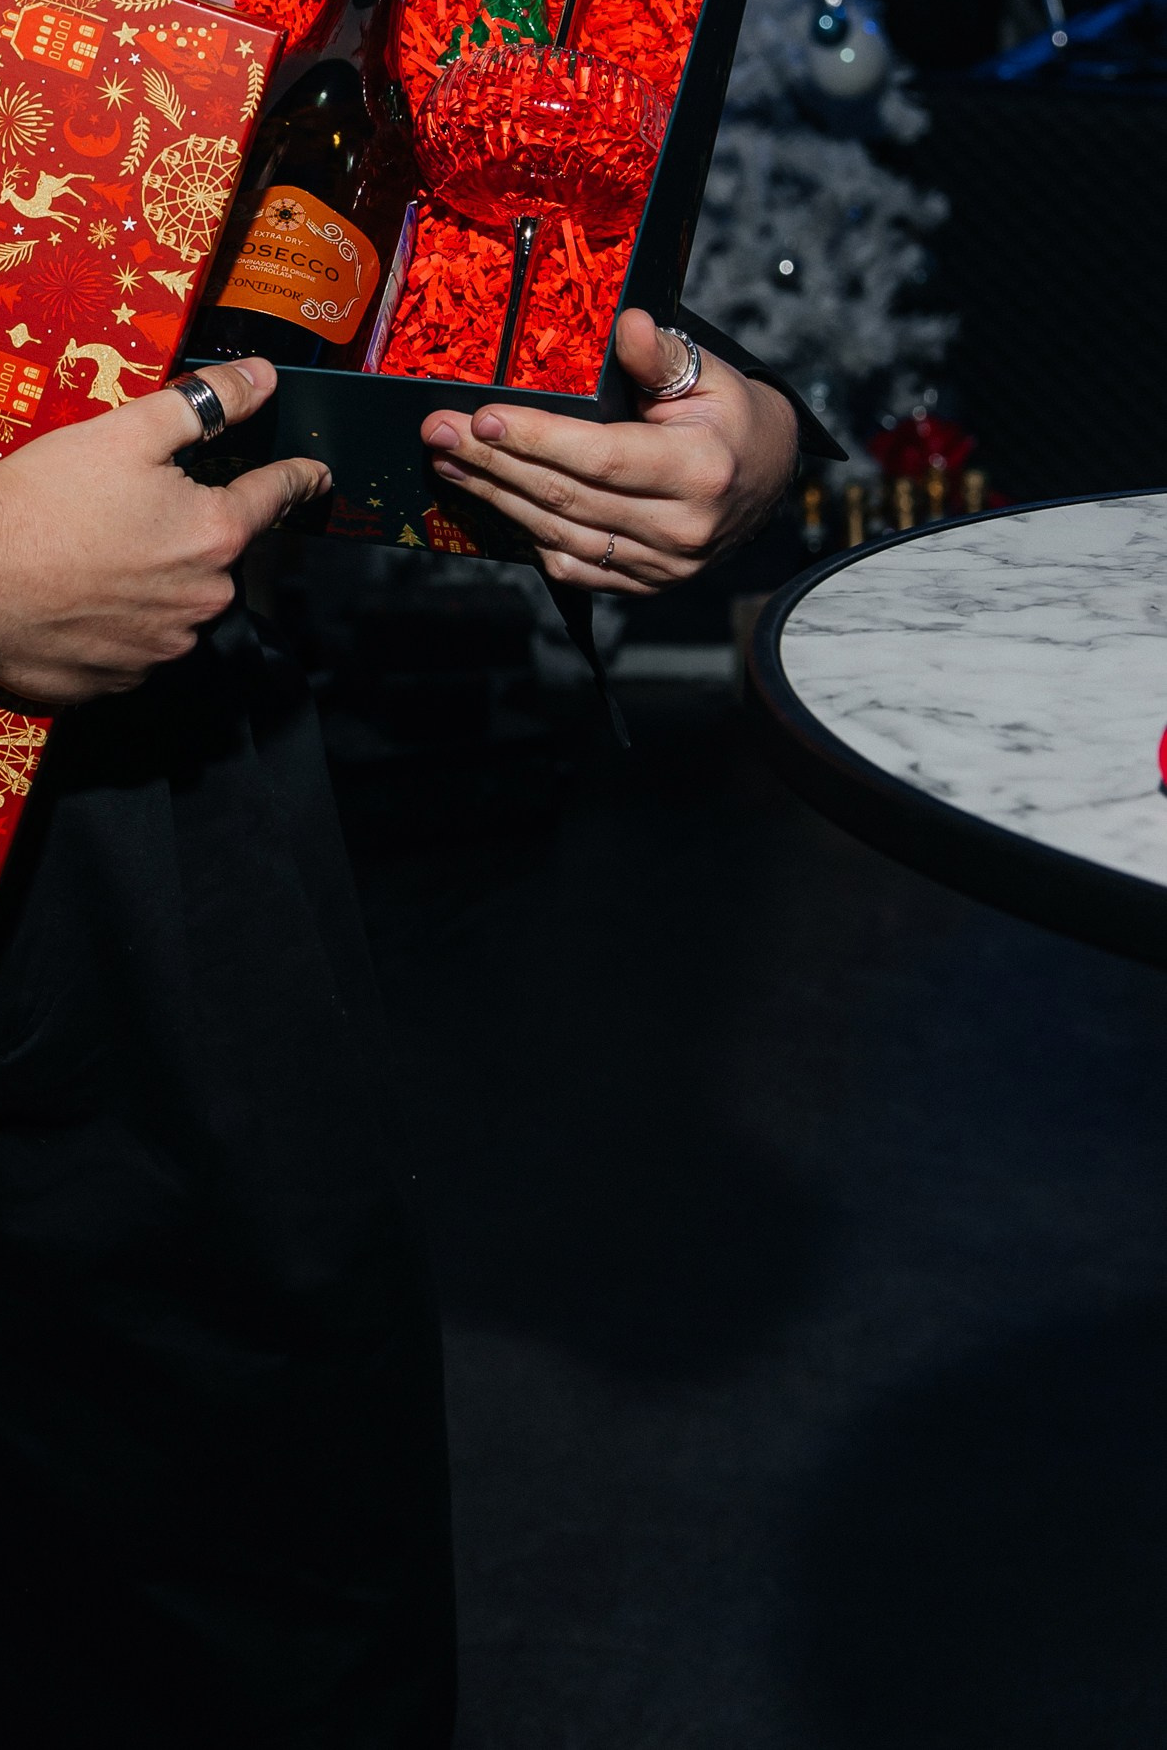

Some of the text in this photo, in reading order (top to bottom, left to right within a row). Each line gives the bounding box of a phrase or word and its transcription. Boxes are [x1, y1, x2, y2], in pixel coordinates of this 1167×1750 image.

[254, 230, 304, 246] EXTRA DRY
[234, 241, 339, 282] OSECCO
[244, 264, 293, 279] CONTROLLATA
[289, 268, 317, 283] ORIGINE
[226, 276, 301, 301] CONTEDOR
